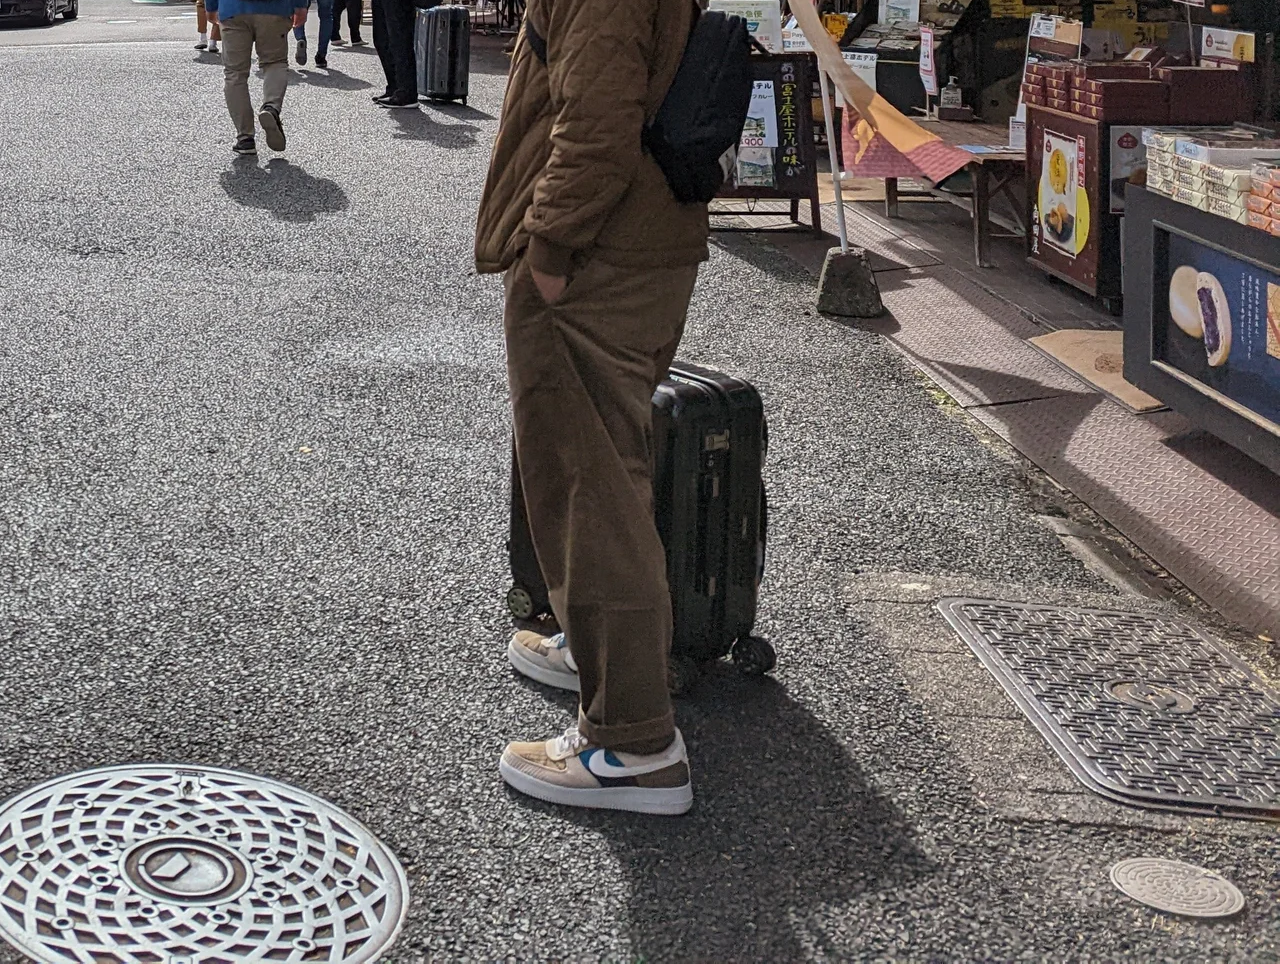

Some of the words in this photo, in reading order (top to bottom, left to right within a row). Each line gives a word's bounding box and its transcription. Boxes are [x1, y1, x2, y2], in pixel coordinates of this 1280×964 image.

[842, 53, 876, 62] 士屋ホテル
